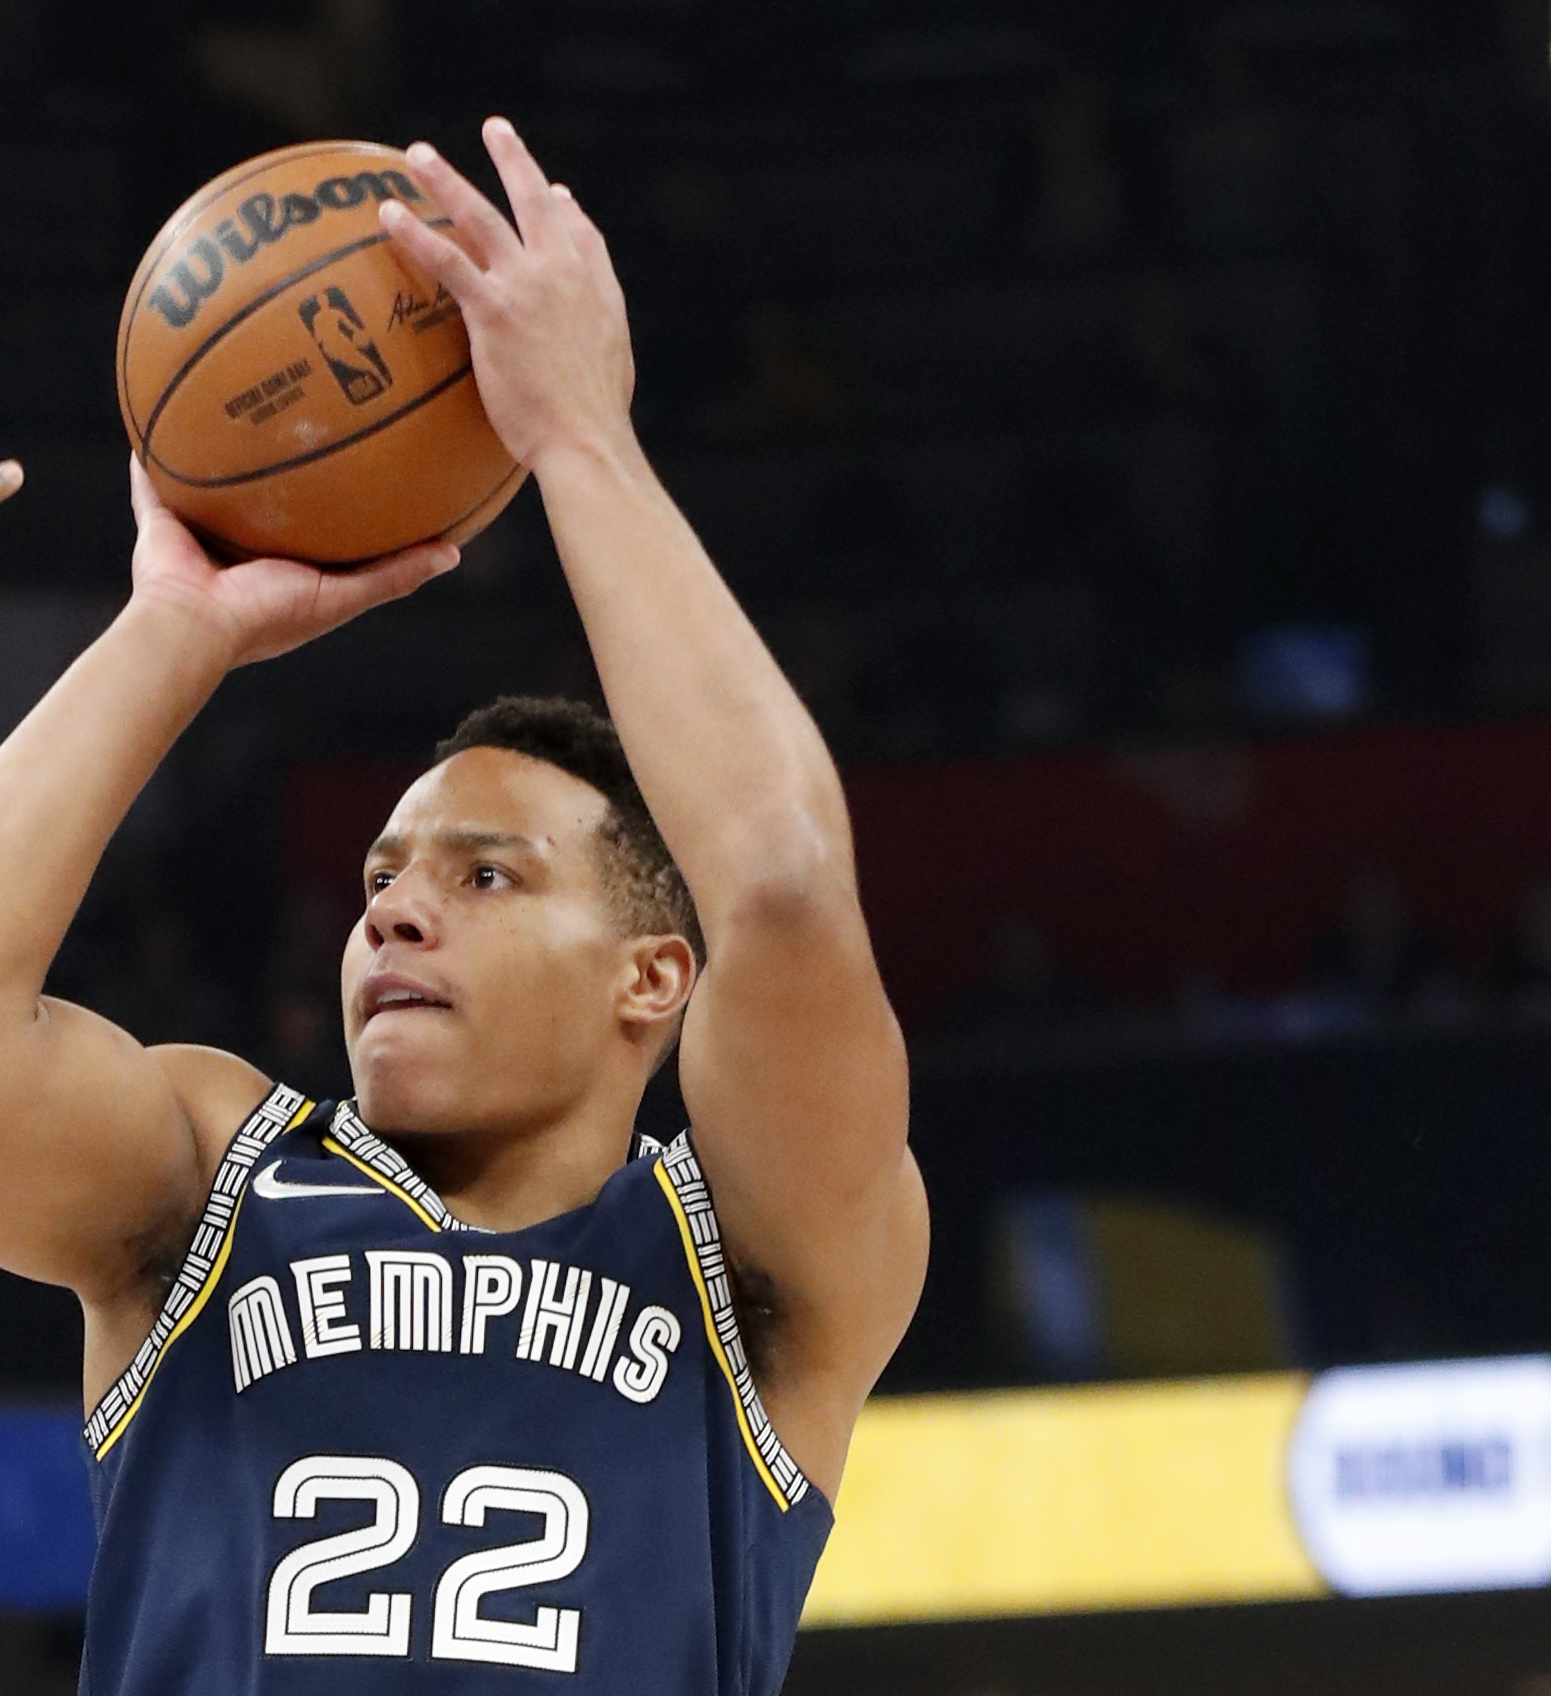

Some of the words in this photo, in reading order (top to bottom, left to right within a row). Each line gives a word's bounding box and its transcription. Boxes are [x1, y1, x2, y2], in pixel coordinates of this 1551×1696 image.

[147, 169, 426, 329] Wilson
[227, 1250, 682, 1404] MEMPHIS
[264, 1455, 590, 1674] 22
